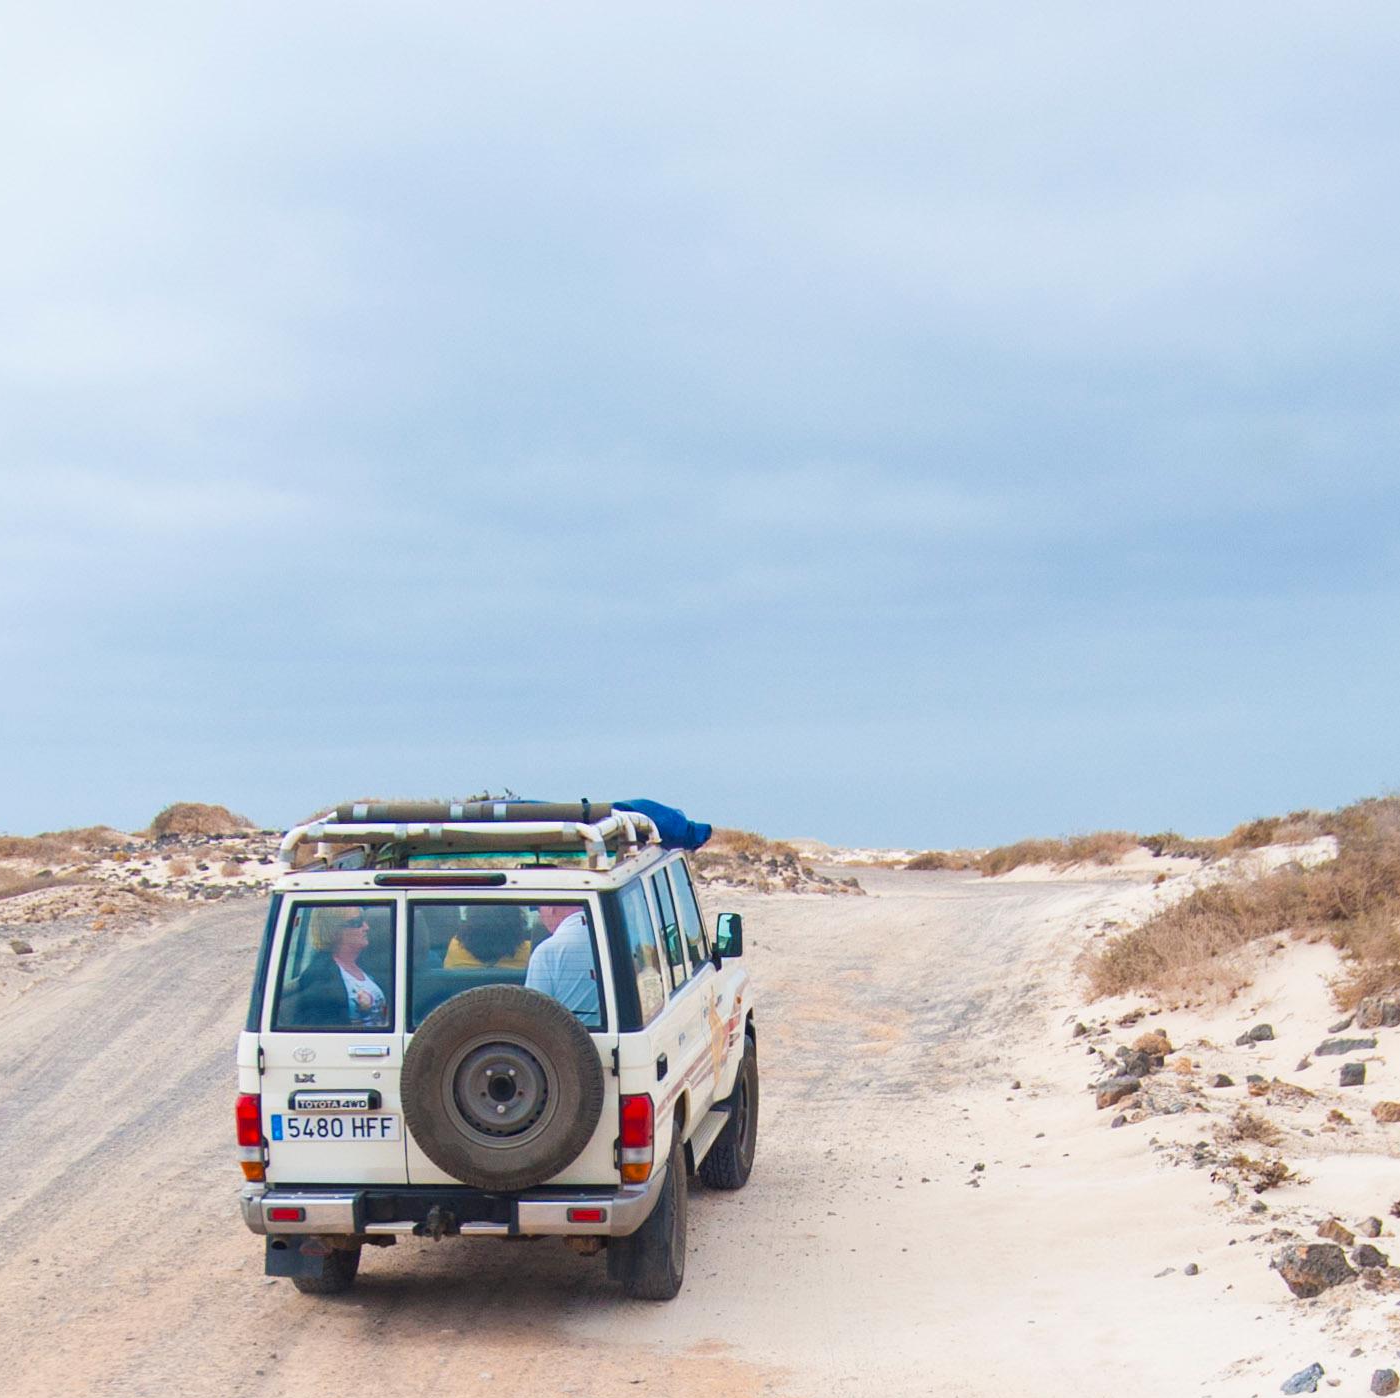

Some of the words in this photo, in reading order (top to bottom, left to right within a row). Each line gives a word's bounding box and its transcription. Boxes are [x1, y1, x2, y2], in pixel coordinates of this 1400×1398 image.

[294, 1073, 316, 1083] LX
[299, 1100, 339, 1109] TOYOTA
[341, 1100, 367, 1109] 4WD
[287, 1117, 344, 1139] 5480
[351, 1116, 393, 1138] HFF
